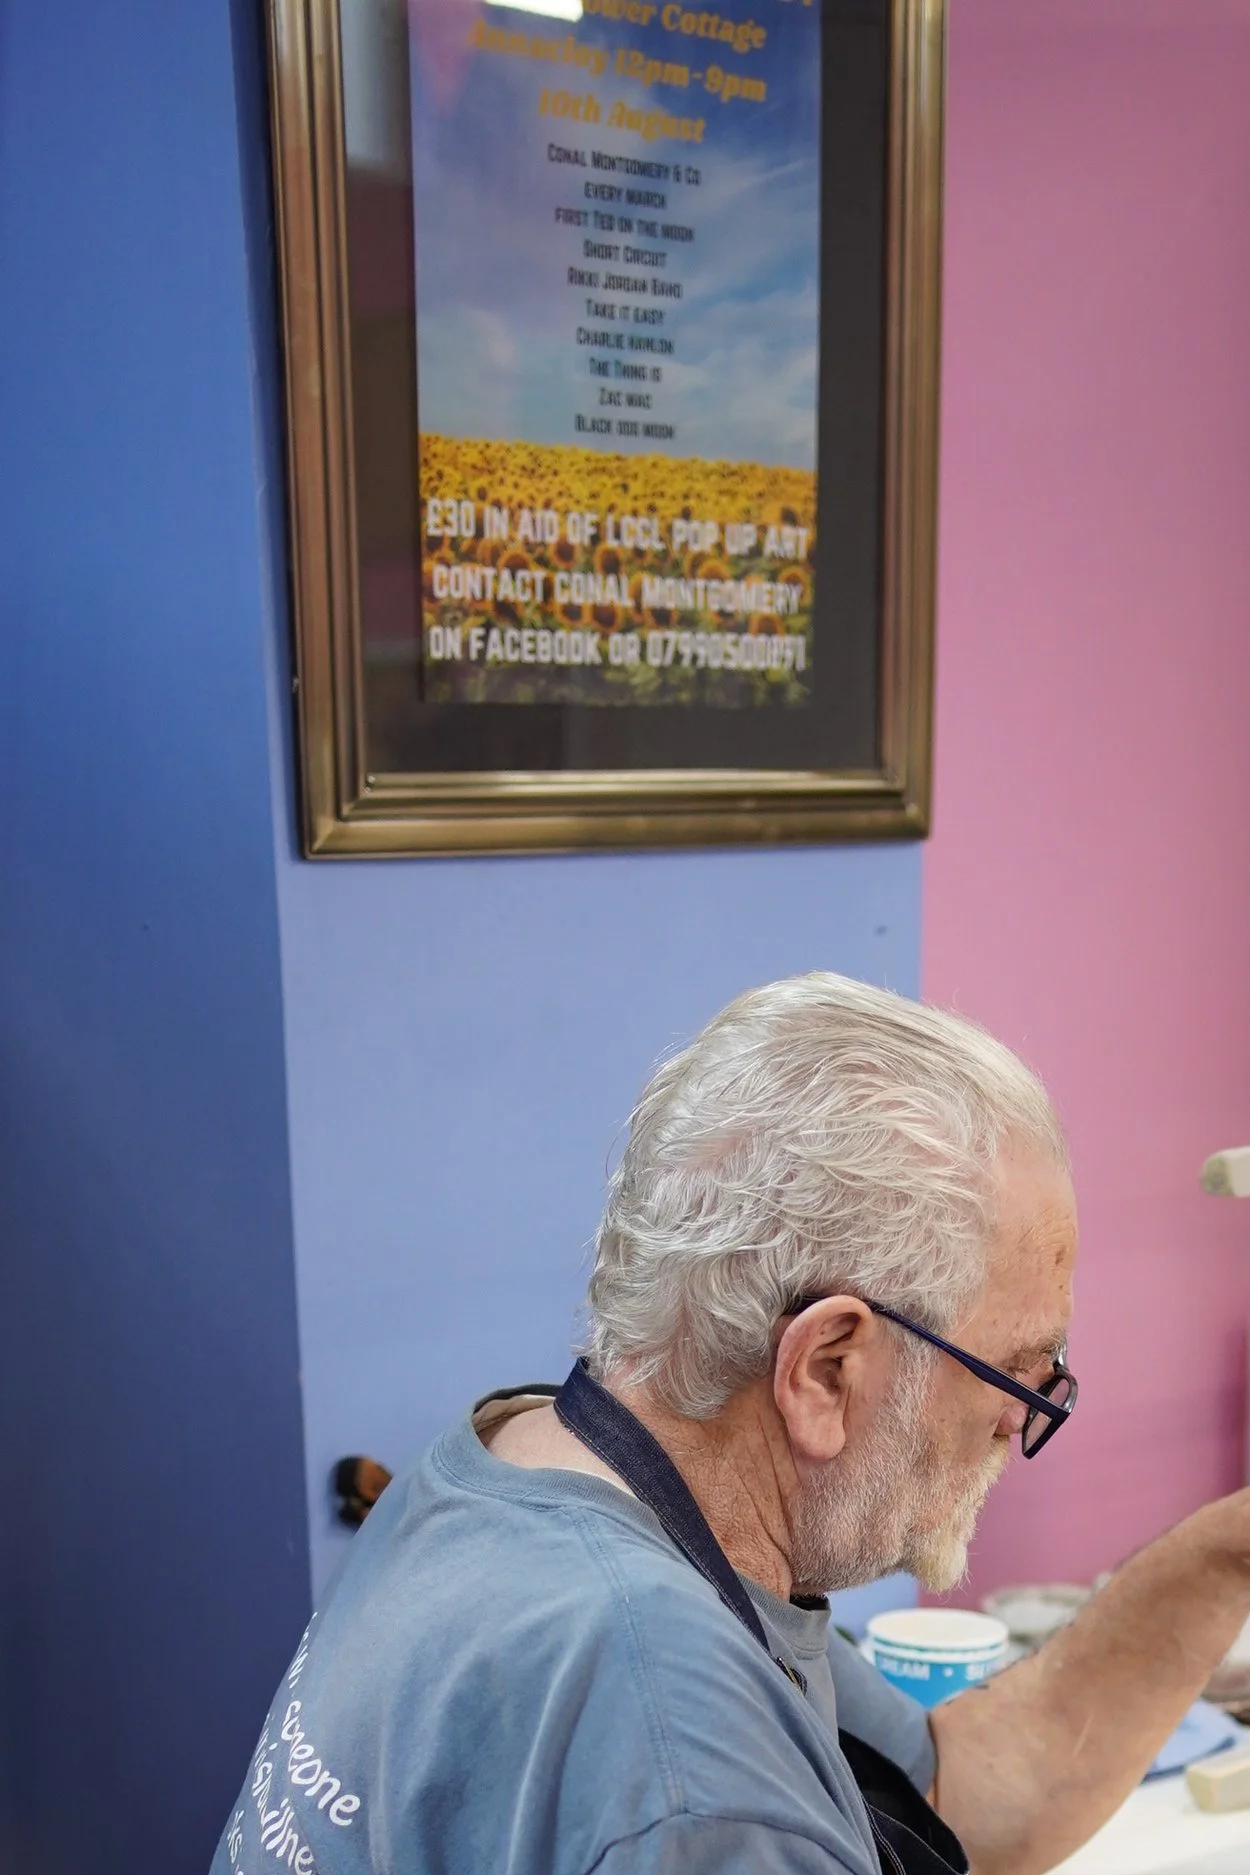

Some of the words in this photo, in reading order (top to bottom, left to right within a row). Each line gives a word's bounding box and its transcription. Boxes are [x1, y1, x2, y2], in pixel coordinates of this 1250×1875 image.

[661, 4, 767, 53] Cottage
[607, 99, 705, 141] August
[484, 505, 508, 538] IN
[518, 507, 559, 542] AID
[567, 512, 599, 545] OF
[672, 518, 719, 555] POP
[725, 522, 757, 555] UP
[764, 524, 808, 559] ART
[432, 564, 547, 602] CONTACT
[554, 570, 633, 607] CONAL
[641, 575, 803, 614] MONTGOMERY
[429, 625, 463, 660] ON
[469, 627, 602, 665] FACEBOOK
[608, 629, 641, 666] OR
